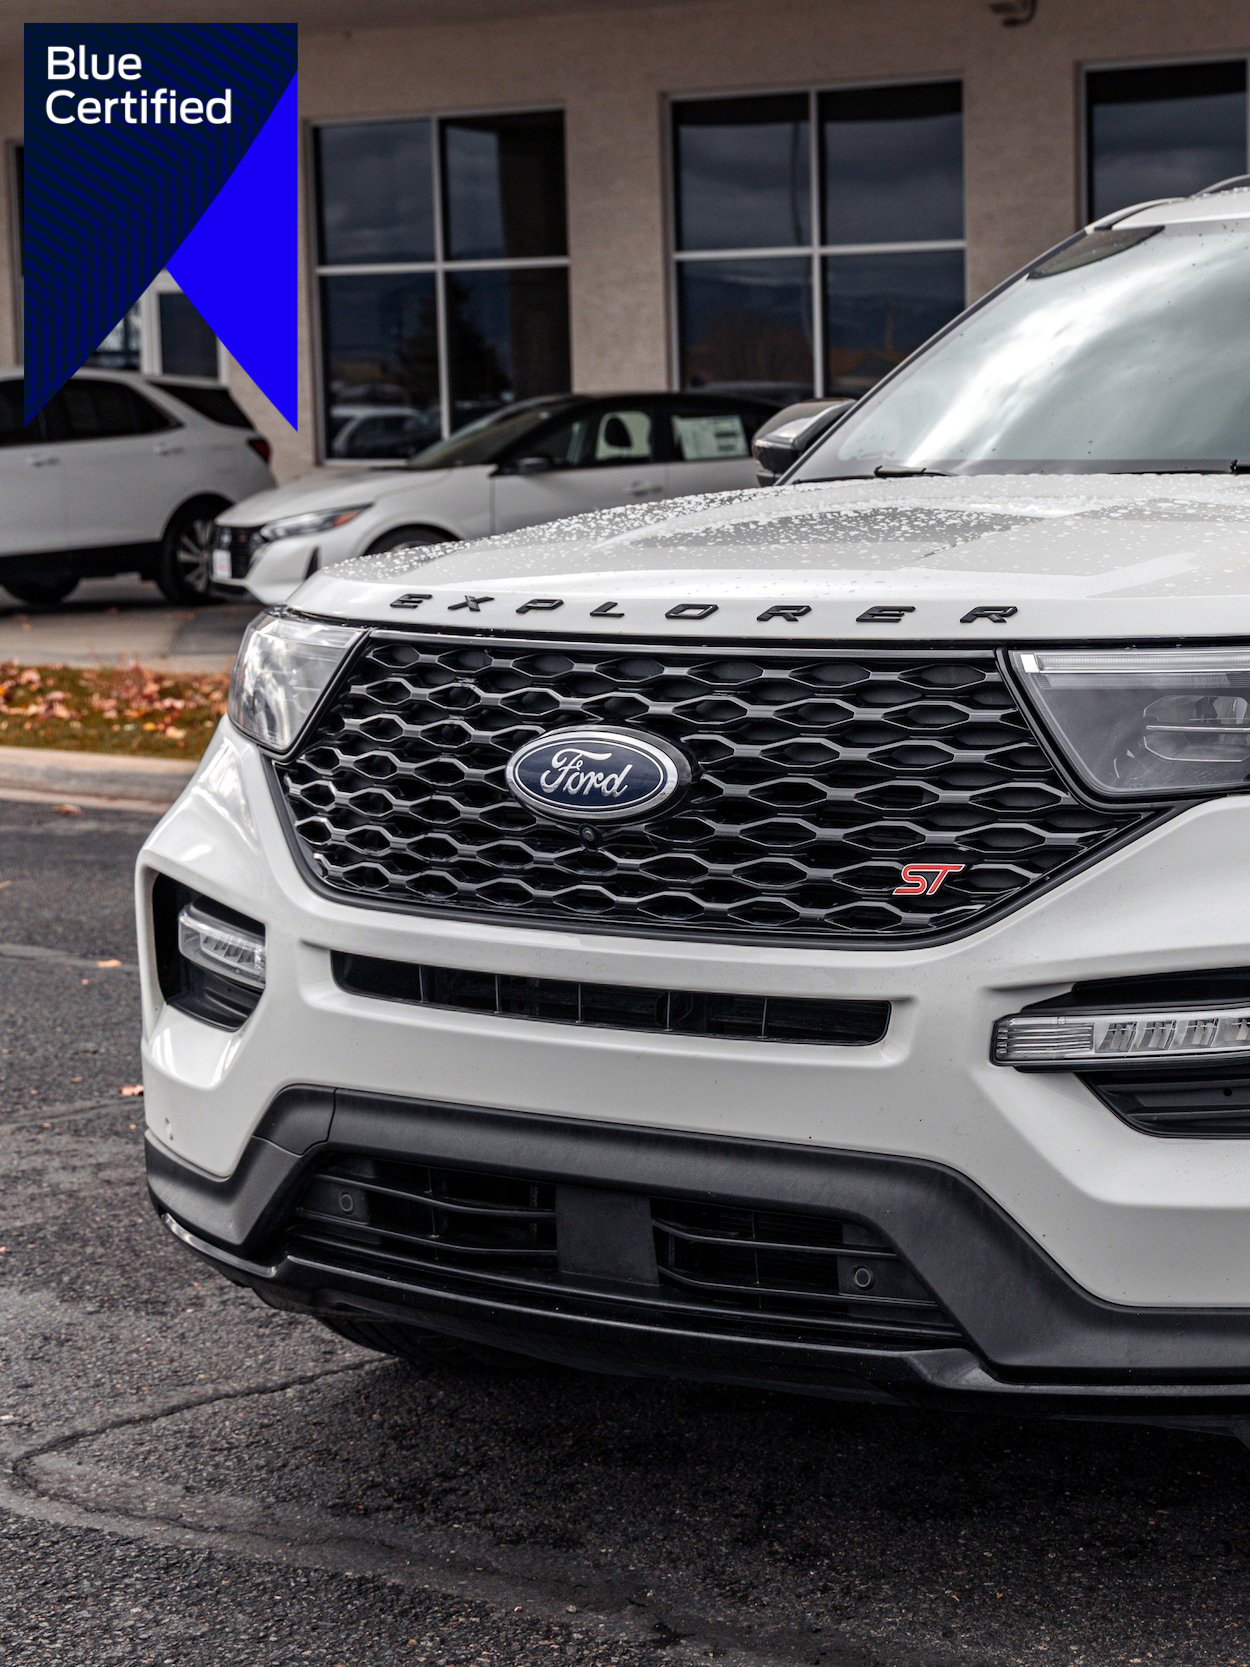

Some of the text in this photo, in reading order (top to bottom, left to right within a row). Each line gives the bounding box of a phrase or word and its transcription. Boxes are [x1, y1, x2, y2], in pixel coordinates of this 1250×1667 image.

[389, 593, 1019, 624] EXPLORER
[540, 748, 633, 798] Ford
[892, 863, 966, 896] ST
